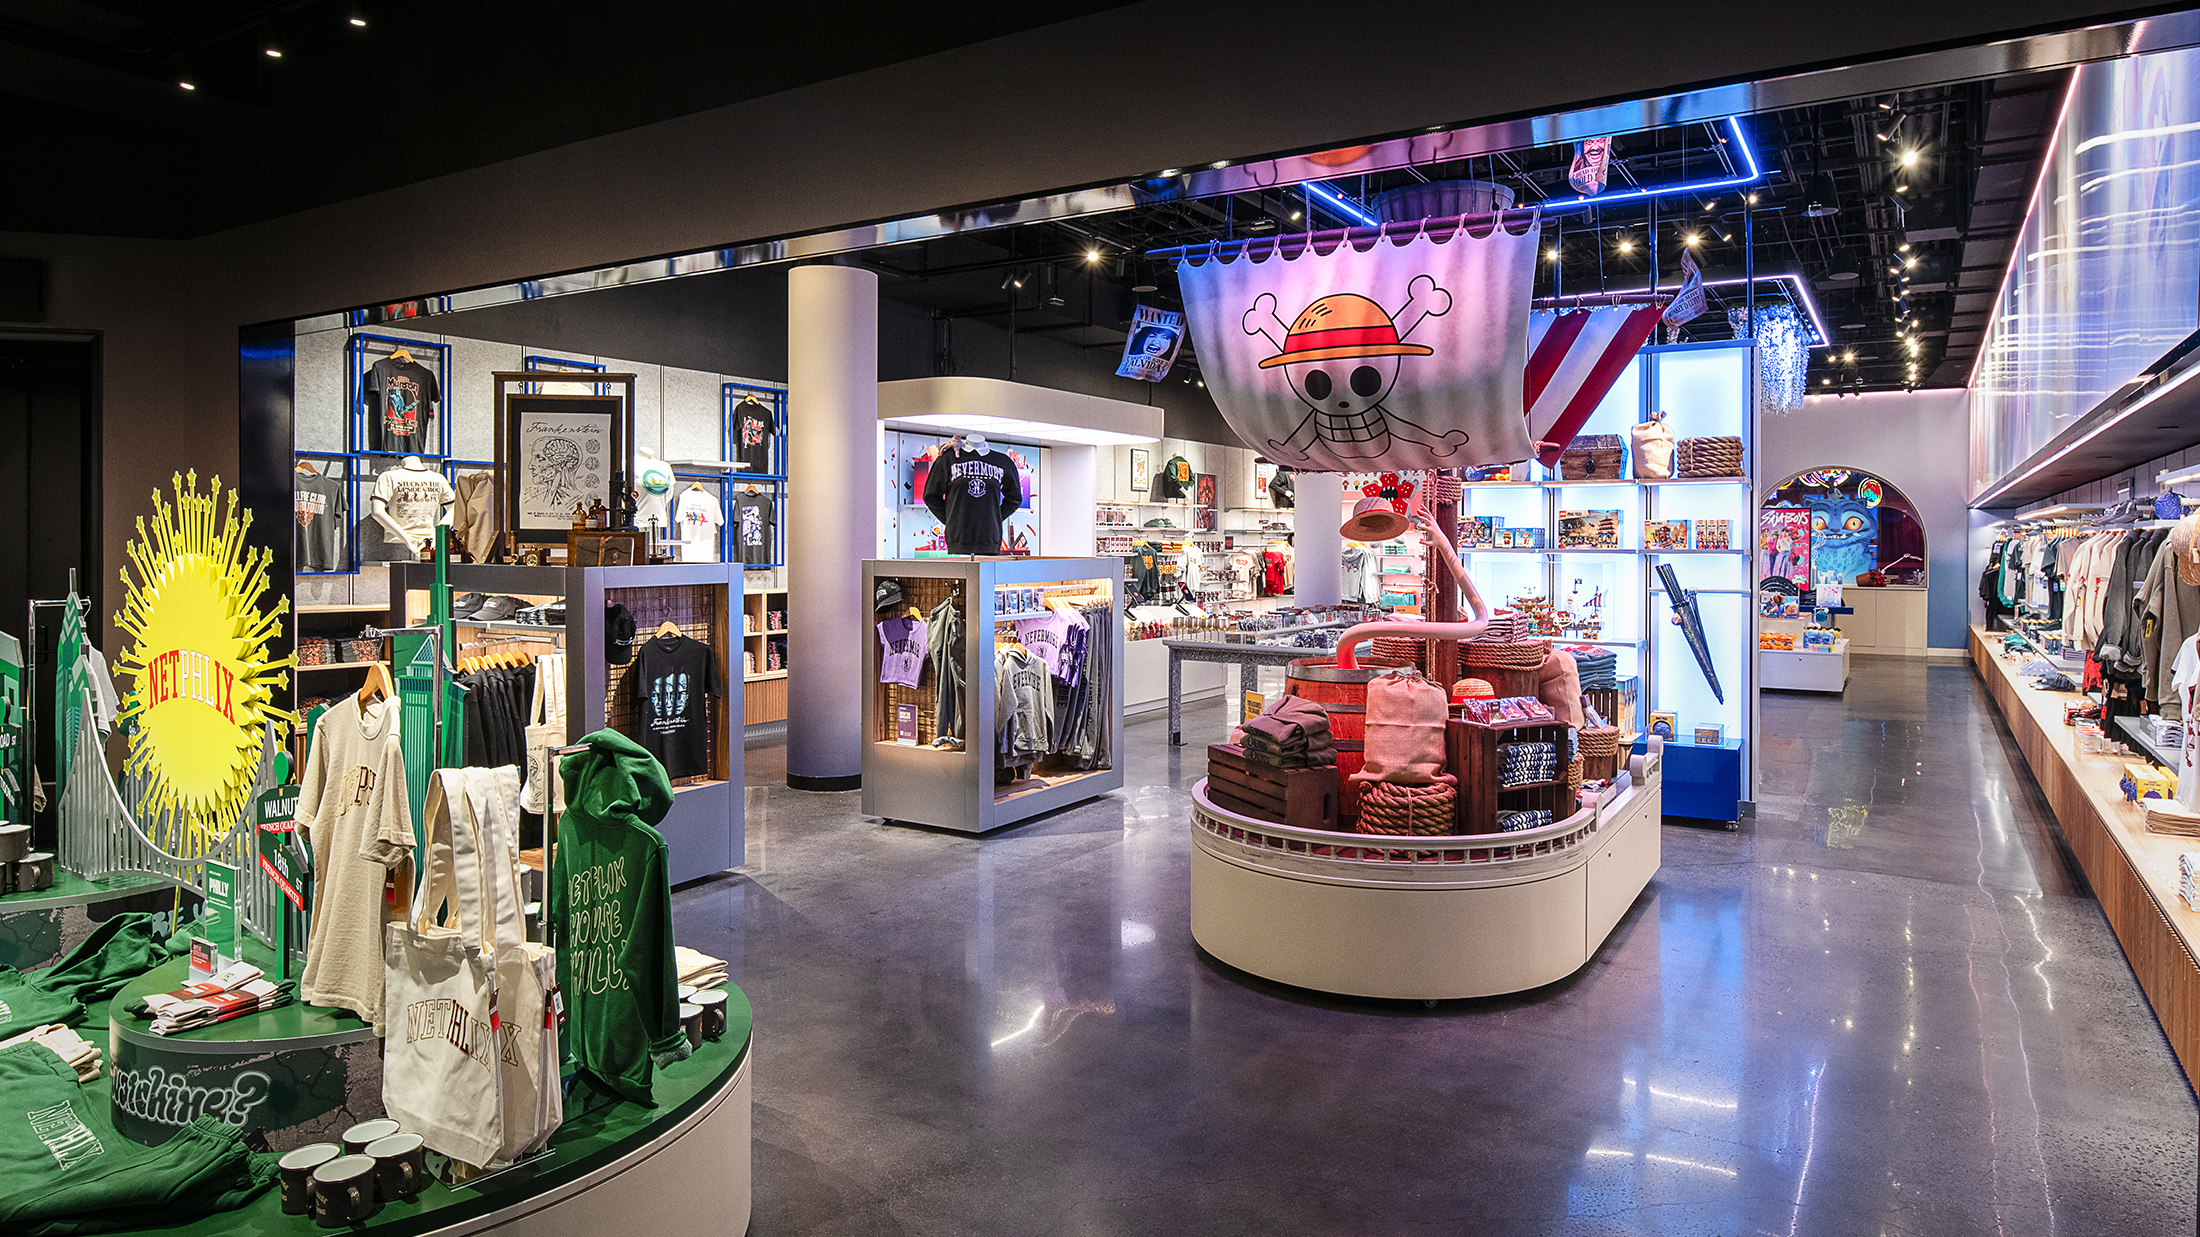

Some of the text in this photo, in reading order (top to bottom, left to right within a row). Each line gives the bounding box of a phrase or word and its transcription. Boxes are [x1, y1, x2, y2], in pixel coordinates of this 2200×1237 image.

[1139, 309, 1184, 326] WANTED
[526, 421, 603, 434] Frankenstein
[950, 460, 1004, 483] NEVERMORE
[148, 649, 235, 725] NETPHLIX
[264, 797, 299, 818] WALNUT
[208, 877, 229, 898] PHILLY
[262, 858, 301, 907] FRENCH QUARTER
[273, 849, 302, 893] 18th ST
[569, 856, 627, 907] ETFLIX
[570, 900, 623, 948] HOUSE
[570, 940, 629, 996] HILL
